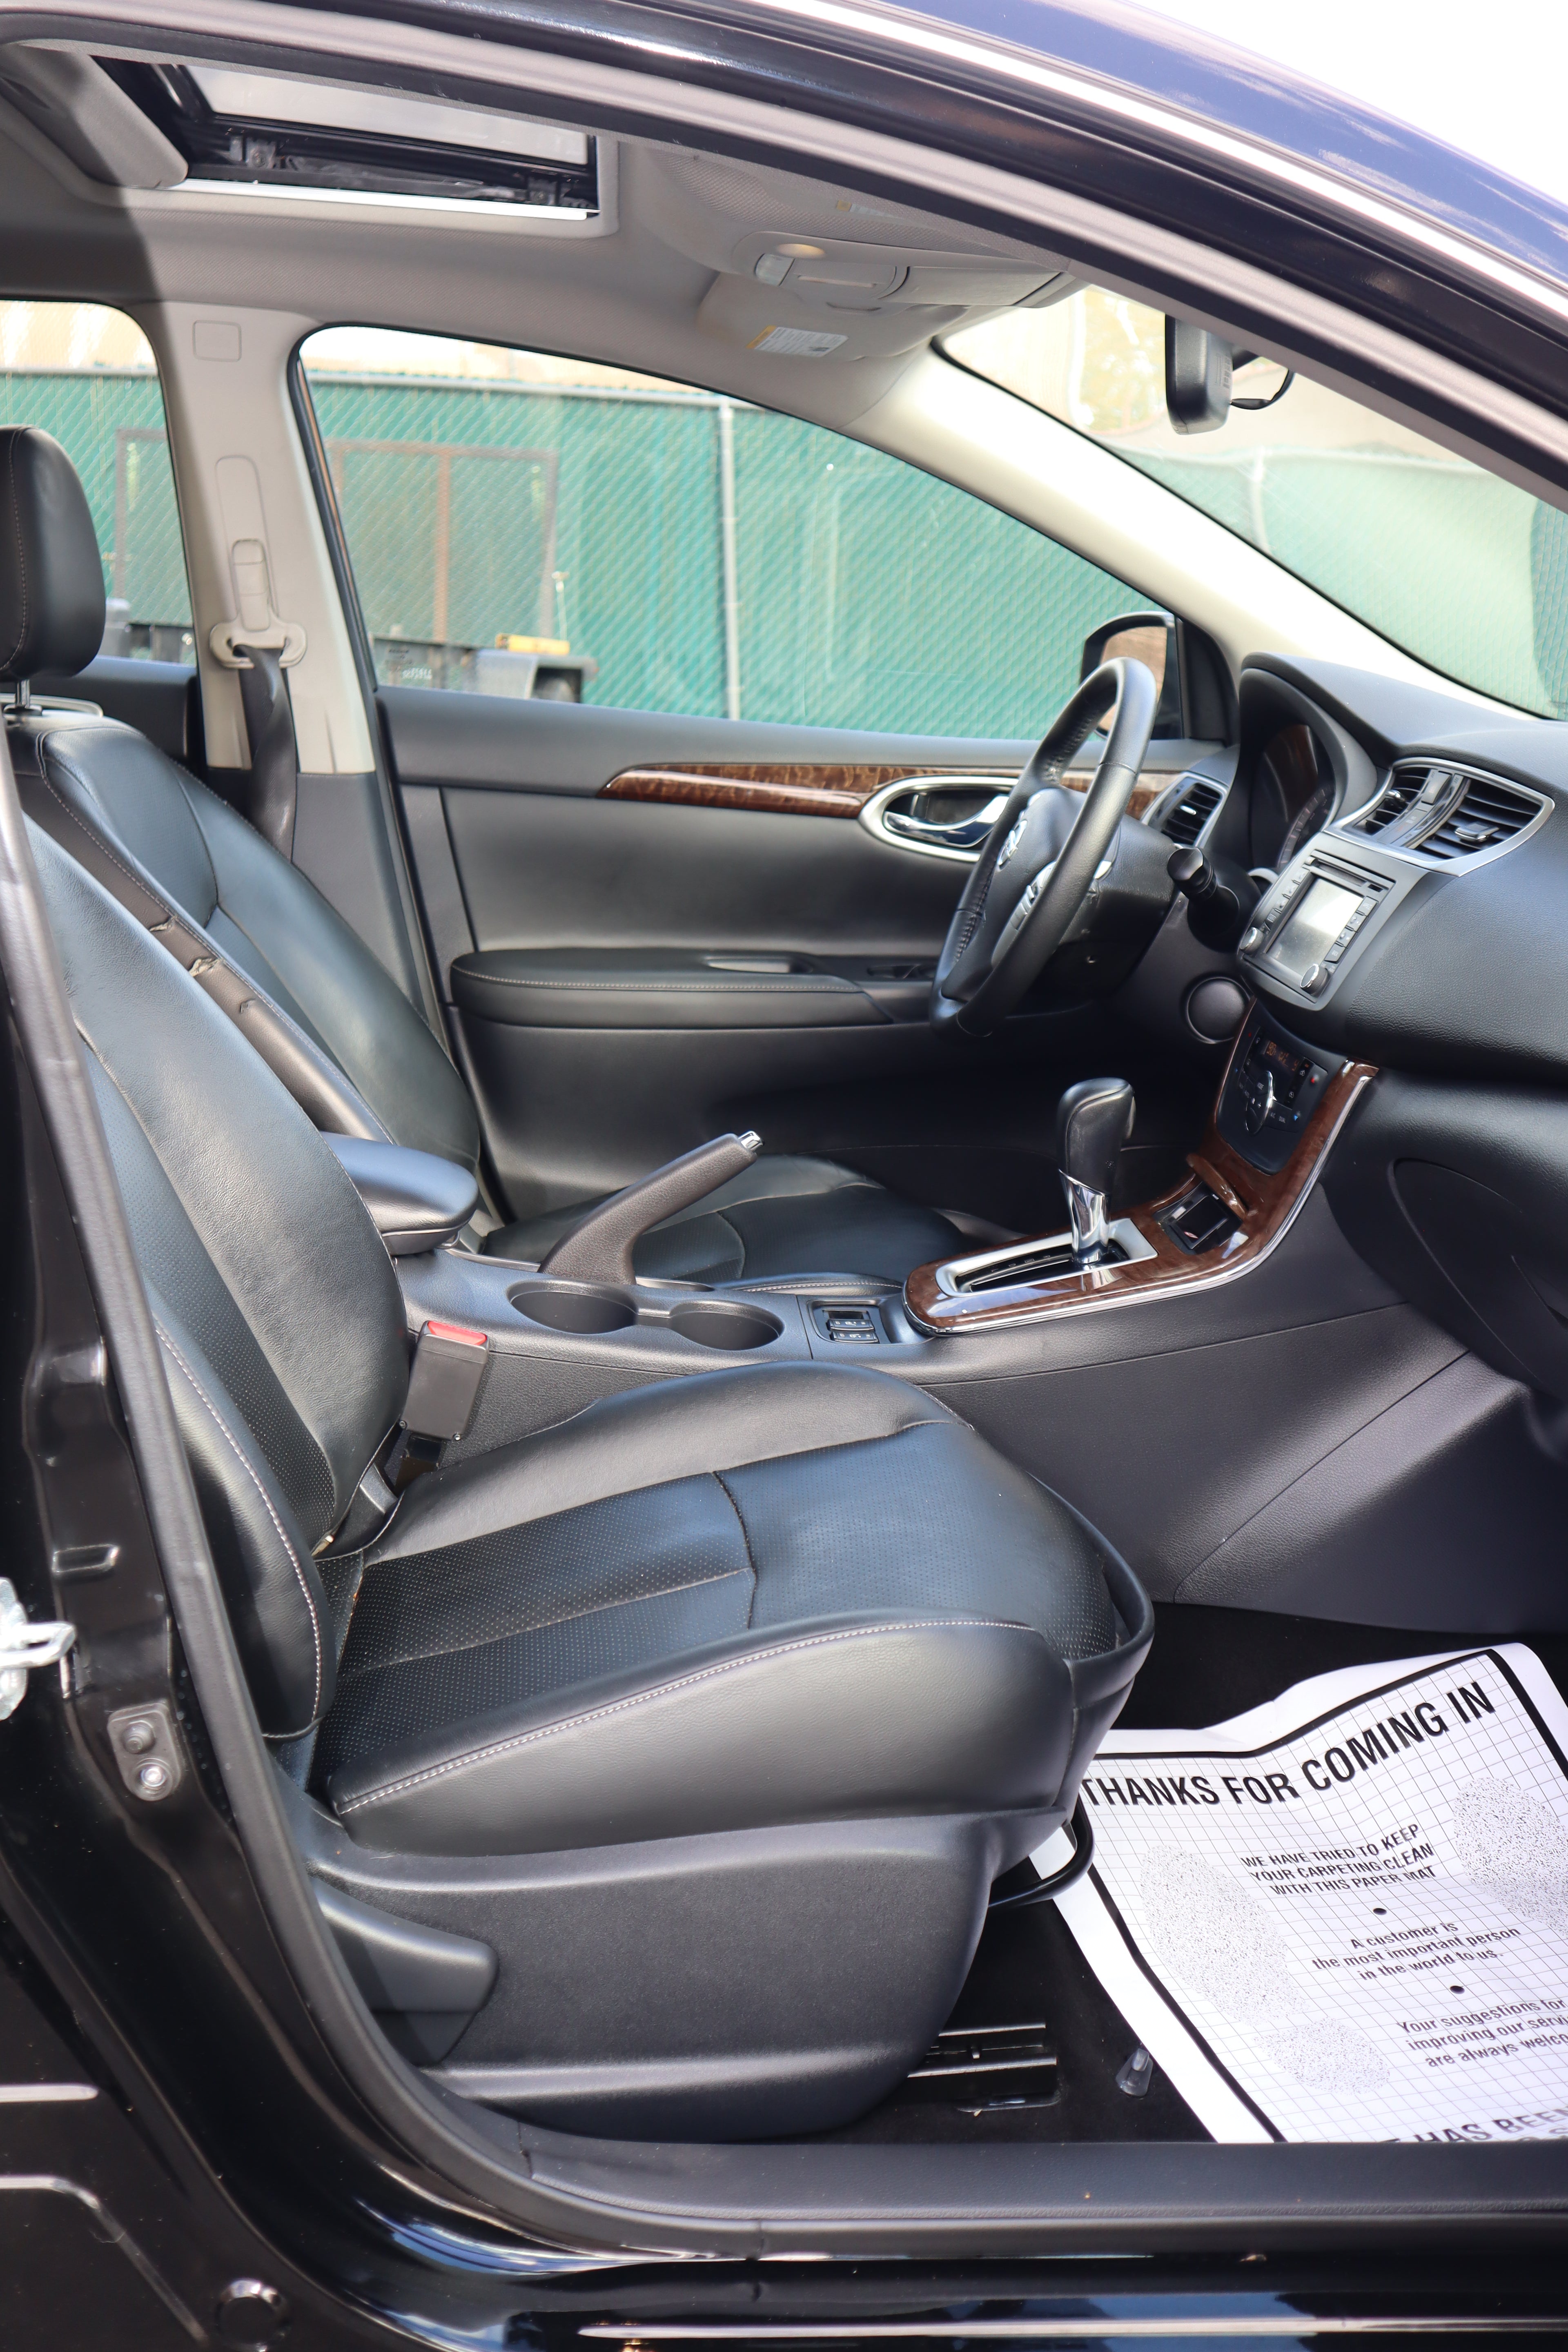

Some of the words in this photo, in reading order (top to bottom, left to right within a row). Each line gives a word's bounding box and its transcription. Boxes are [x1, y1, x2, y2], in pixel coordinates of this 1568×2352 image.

[1082, 1776, 1220, 1805] THANKS
[1220, 1773, 1301, 1804] FOR
[1302, 1702, 1450, 1790] COMING
[1446, 1681, 1496, 1724] IN
[1240, 1856, 1268, 1867] WE
[1268, 1853, 1310, 1865] HAVE
[1309, 1849, 1356, 1861] TRIED
[1356, 1844, 1379, 1857] TO
[1381, 1824, 1419, 1851] KEEP
[1250, 1869, 1296, 1881] YOUR
[1297, 1862, 1383, 1878] CARPETING
[1383, 1843, 1434, 1870] CLEAN
[1269, 1883, 1313, 1895] WITH
[1312, 1879, 1350, 1891] THIS
[1351, 1874, 1403, 1888] PAPER
[1403, 1865, 1437, 1880] MAT
[1312, 1958, 1341, 1969] the
[1343, 1951, 1385, 1966] most
[1385, 1937, 1464, 1958] important
[1466, 1929, 1521, 1947] person
[1350, 1939, 1365, 1949] A
[1366, 1926, 1439, 1946] customer
[1439, 1923, 1459, 1932] is
[1357, 1971, 1377, 1980] in
[1377, 1965, 1406, 1976] the
[1408, 1954, 1456, 1971] world
[1455, 1952, 1474, 1961] to
[1477, 1950, 1503, 1959] us.
[1396, 2020, 1438, 2033] Your
[1441, 2003, 1541, 2027] suggestions
[1540, 2000, 1566, 2010] for
[1405, 2030, 1496, 2050] improving
[1497, 2022, 1525, 2036] our
[1527, 2015, 1568, 2029] servi
[1425, 2055, 1456, 2067] are
[1458, 2044, 1519, 2061] always
